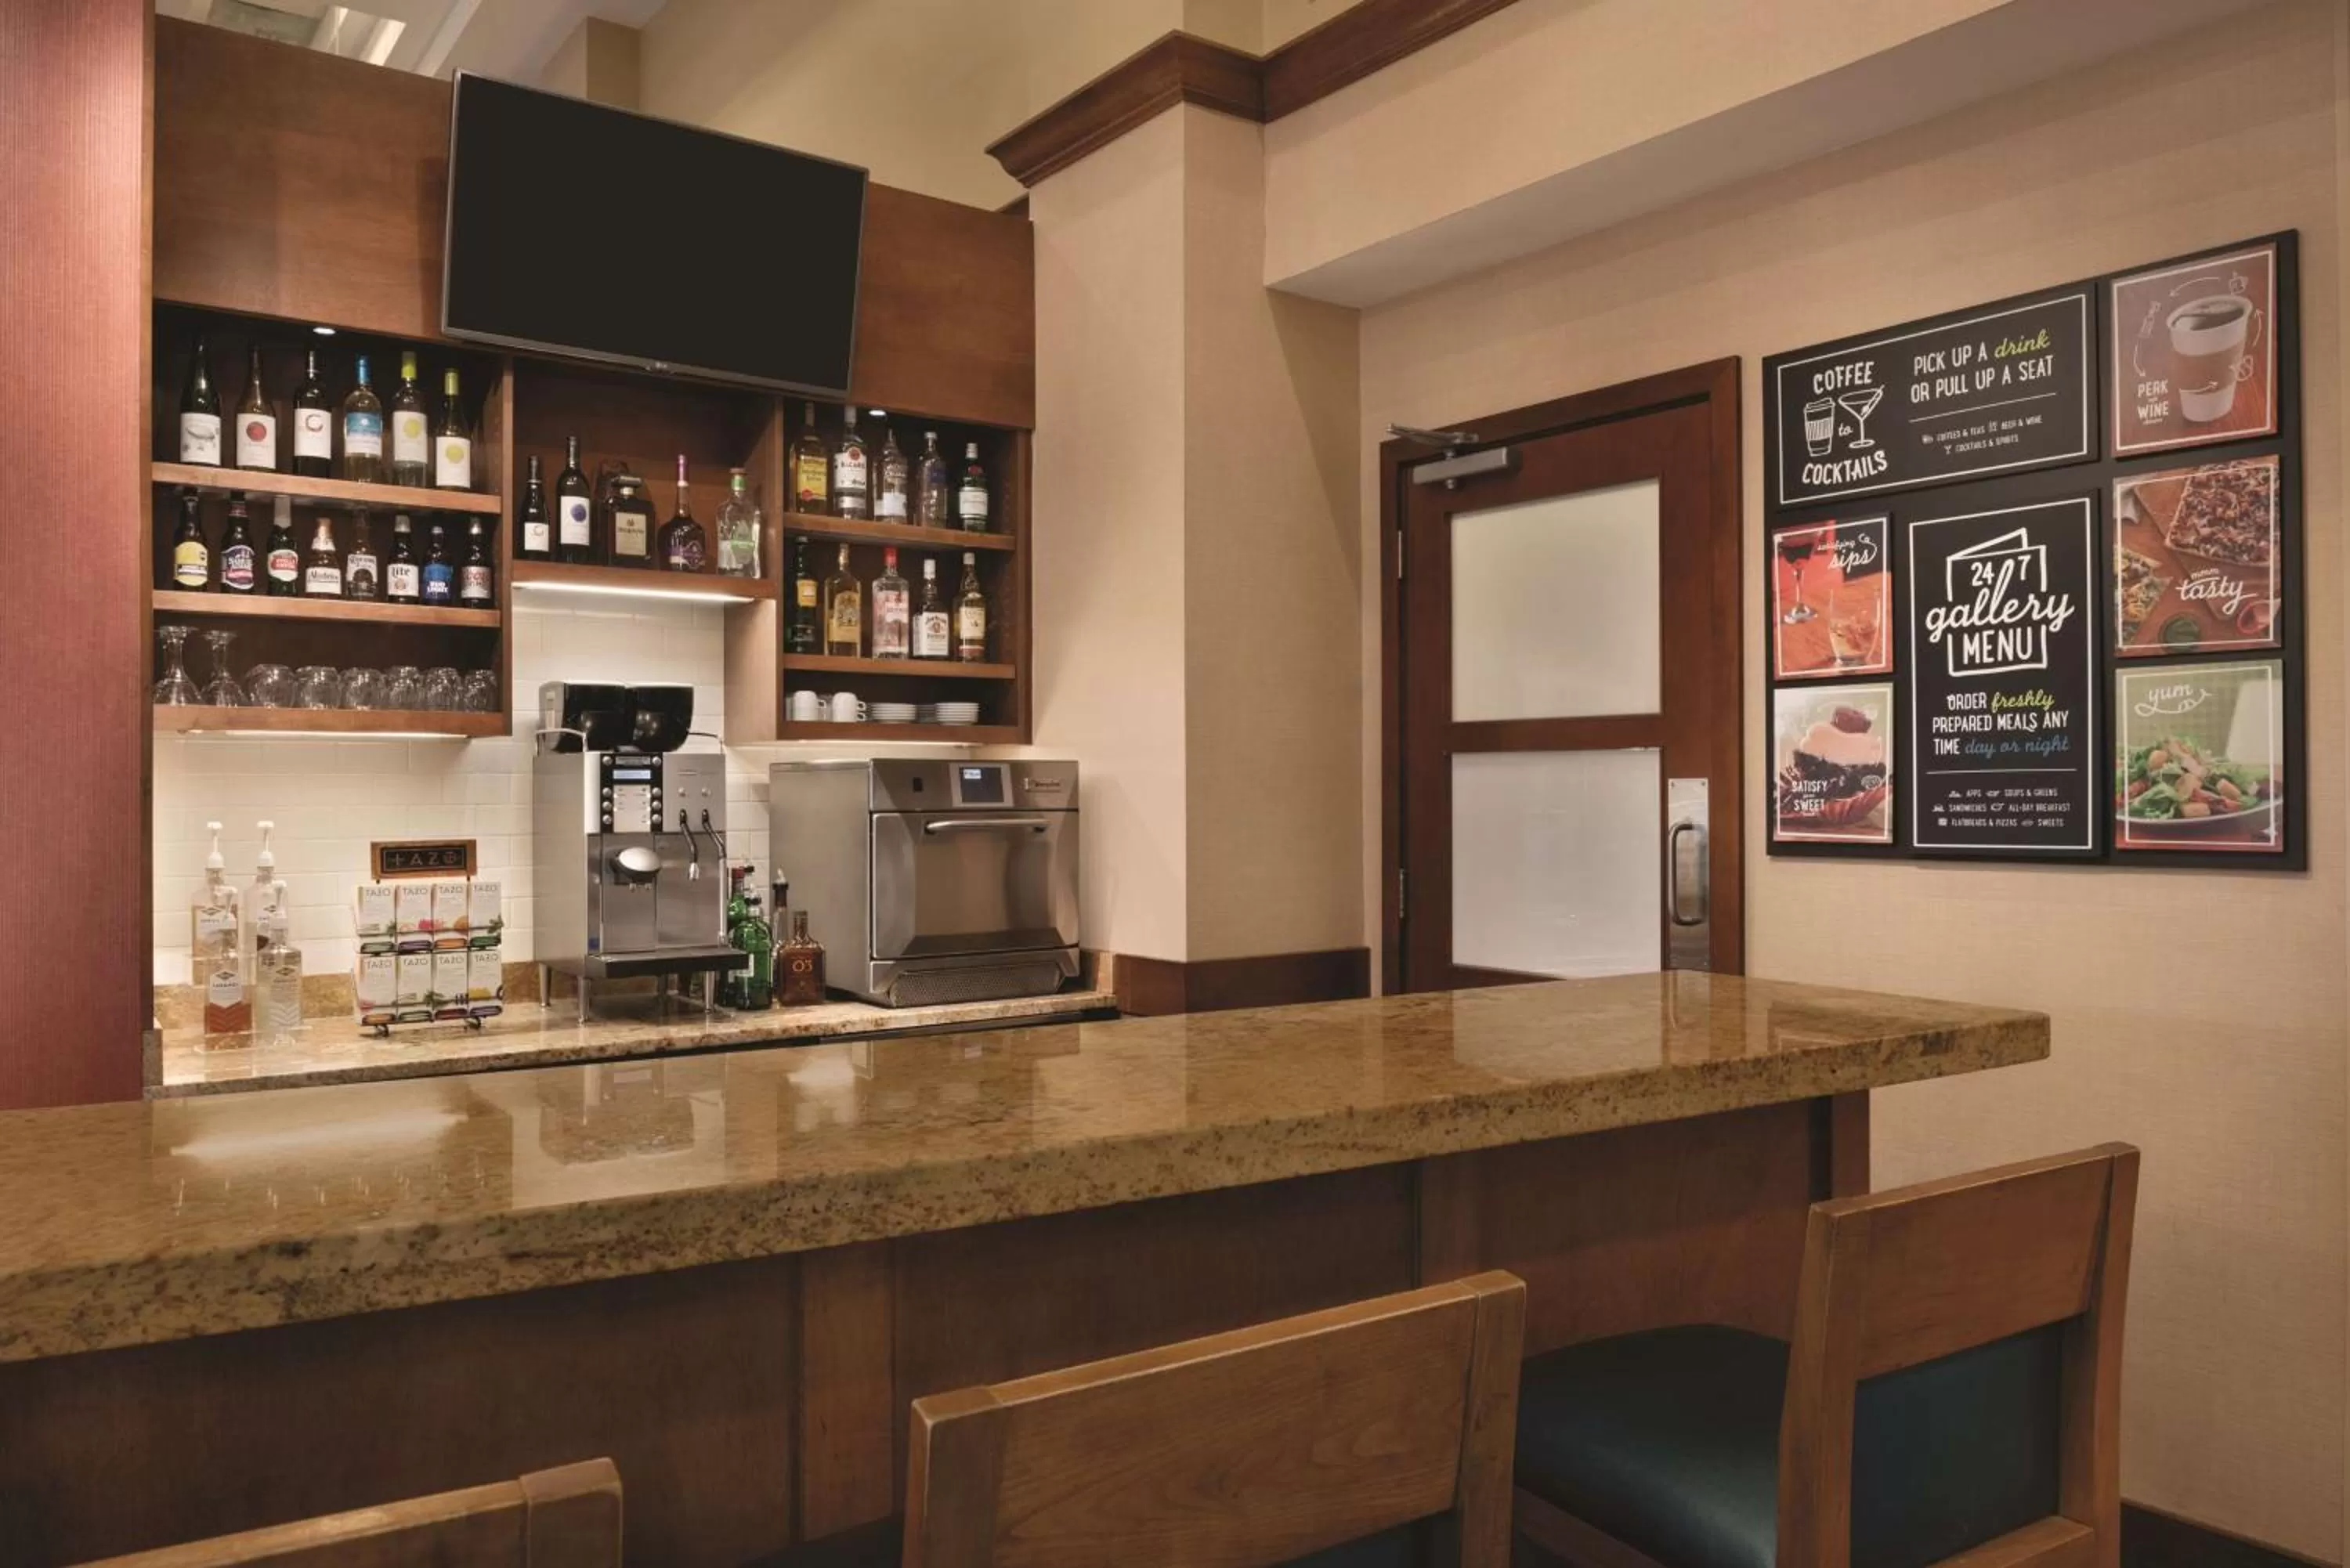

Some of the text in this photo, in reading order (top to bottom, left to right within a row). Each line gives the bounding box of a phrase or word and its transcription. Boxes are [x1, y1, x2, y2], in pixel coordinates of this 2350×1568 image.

[1914, 328, 2051, 376] PICK UP A drink
[1813, 361, 1875, 395] COFFEE
[1911, 354, 2054, 403] OR PULL UP A SEAT
[2137, 401, 2169, 420] WINE
[1838, 423, 1853, 436] to
[1802, 450, 1888, 485] COCKTAILS
[1828, 546, 1877, 573] sips
[1971, 555, 2031, 587] 24 7
[1925, 558, 2075, 643] gallery
[2175, 576, 2258, 615] tasty
[1963, 626, 2033, 664] MENU
[1946, 688, 2055, 713] ORDER freshly
[2134, 684, 2195, 717] yum
[1932, 710, 2069, 733] PREPARED MEALS ANY
[1933, 734, 2070, 759] TIME day or night
[1791, 779, 1828, 793] SATISFY
[1793, 799, 1825, 811] SWEET
[366, 887, 391, 897] TAZO
[403, 887, 428, 896] TAZO
[367, 958, 392, 970] TAZO
[403, 956, 428, 966] TAZO
[439, 955, 464, 965] TAZO
[474, 953, 499, 963] TAZO
